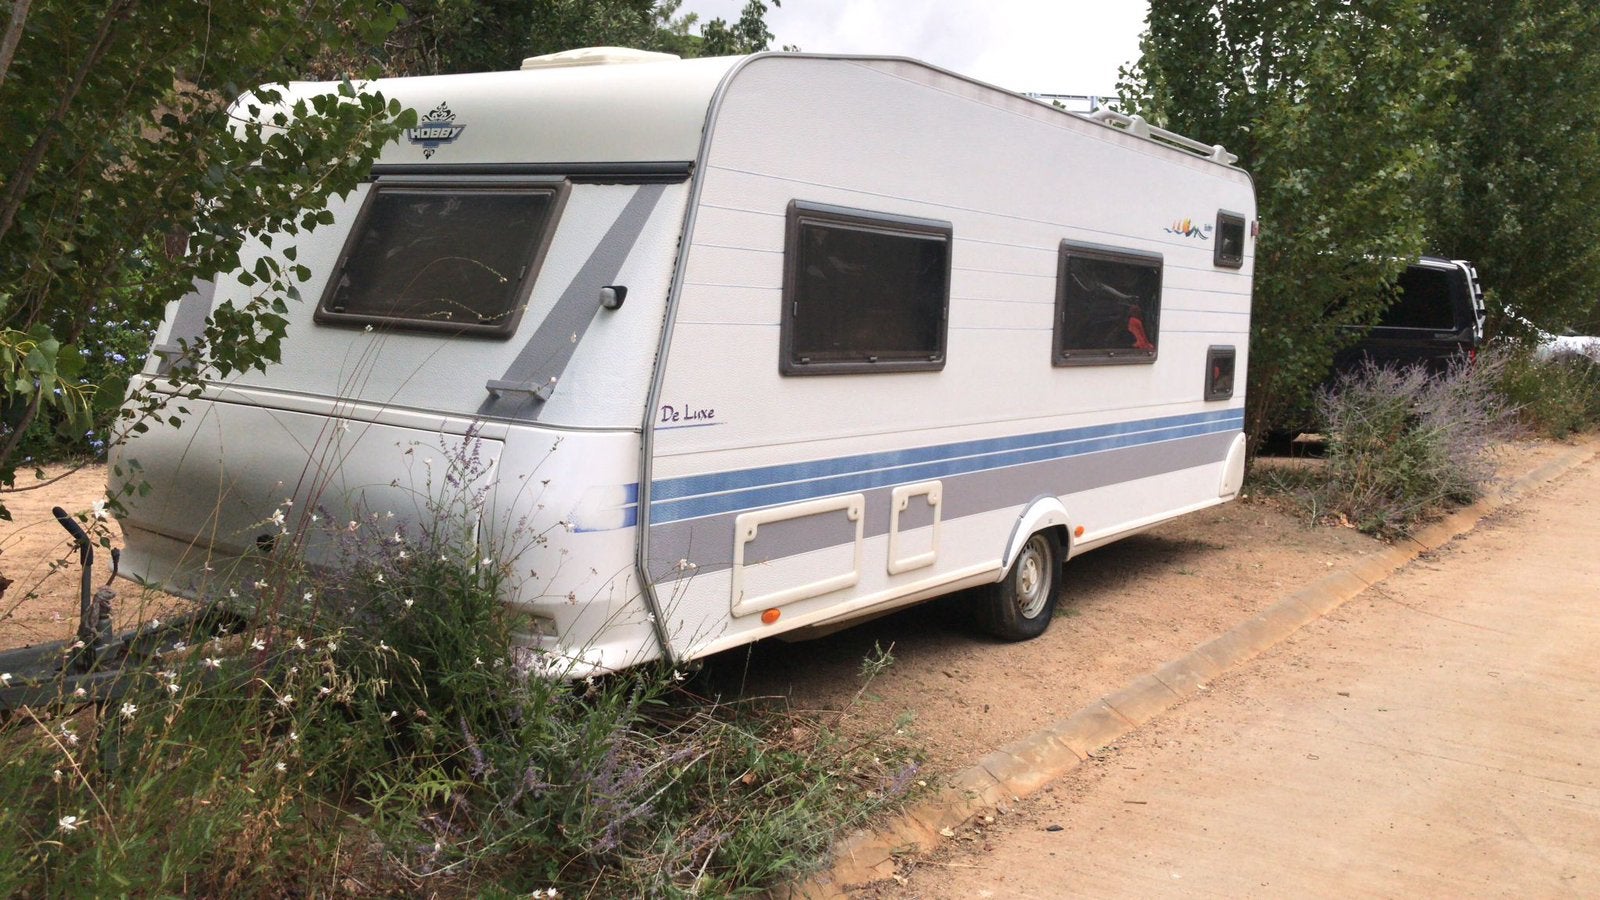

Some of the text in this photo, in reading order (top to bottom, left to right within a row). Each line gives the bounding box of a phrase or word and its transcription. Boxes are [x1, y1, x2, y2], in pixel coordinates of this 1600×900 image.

[410, 127, 462, 139] HOBBY
[661, 404, 715, 422] De Luxe
